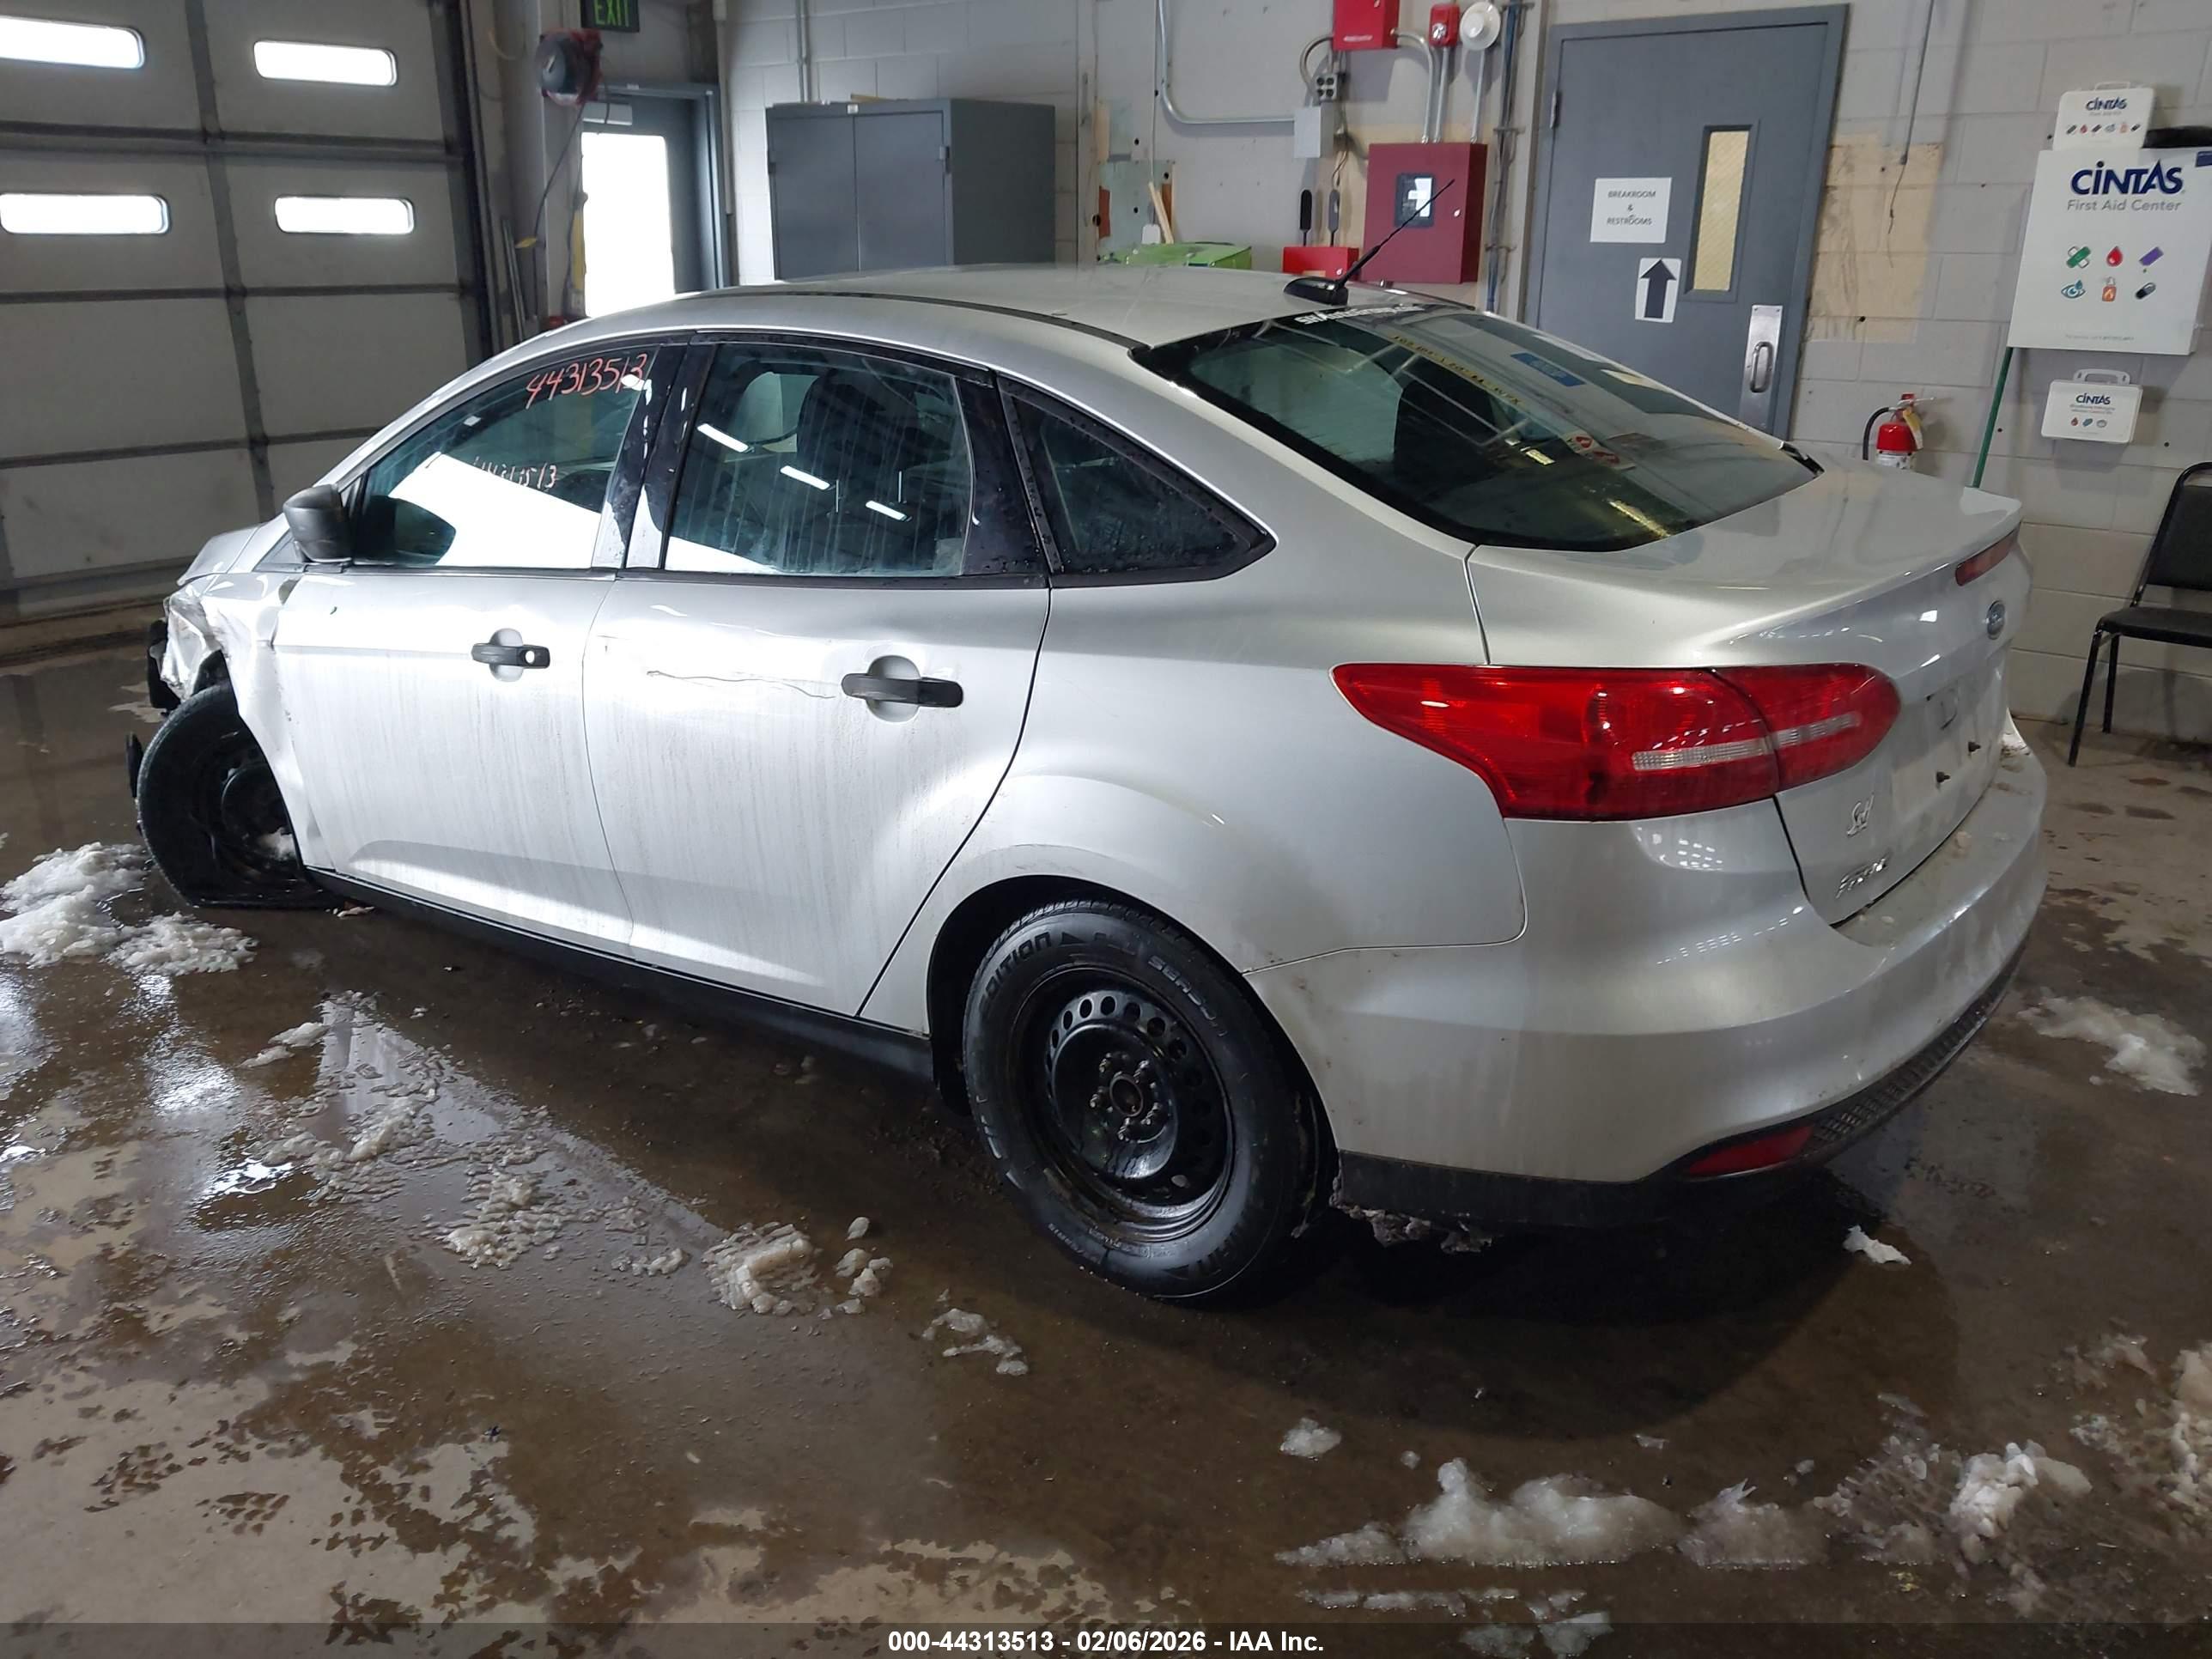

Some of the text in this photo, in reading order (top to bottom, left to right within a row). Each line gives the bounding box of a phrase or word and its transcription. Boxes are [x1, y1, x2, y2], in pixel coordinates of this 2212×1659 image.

[593, 0, 629, 27] EXIT
[1607, 190, 1656, 198] BREAKROOM
[2068, 199, 2182, 211] First Aid Center
